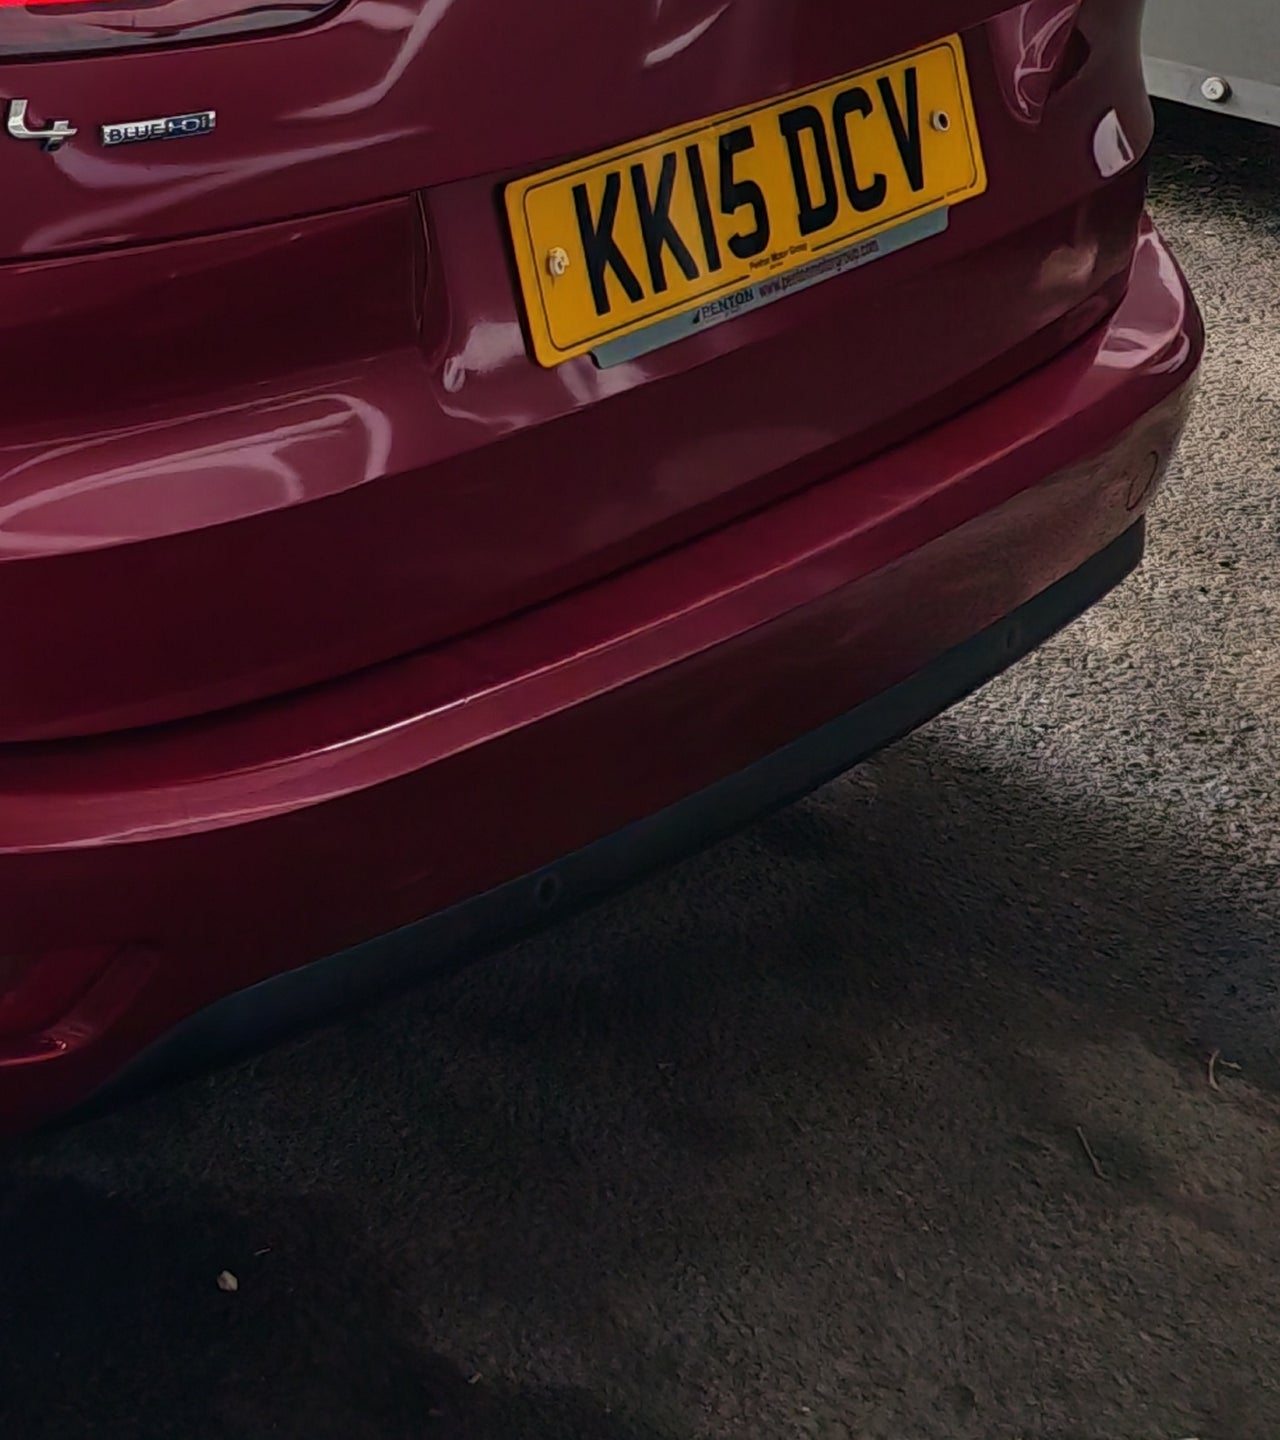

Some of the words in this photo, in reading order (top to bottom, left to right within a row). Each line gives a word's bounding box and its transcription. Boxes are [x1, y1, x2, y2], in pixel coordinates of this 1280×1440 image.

[572, 124, 771, 317] KK15
[778, 66, 926, 237] DCV
[701, 288, 755, 318] PENTON
